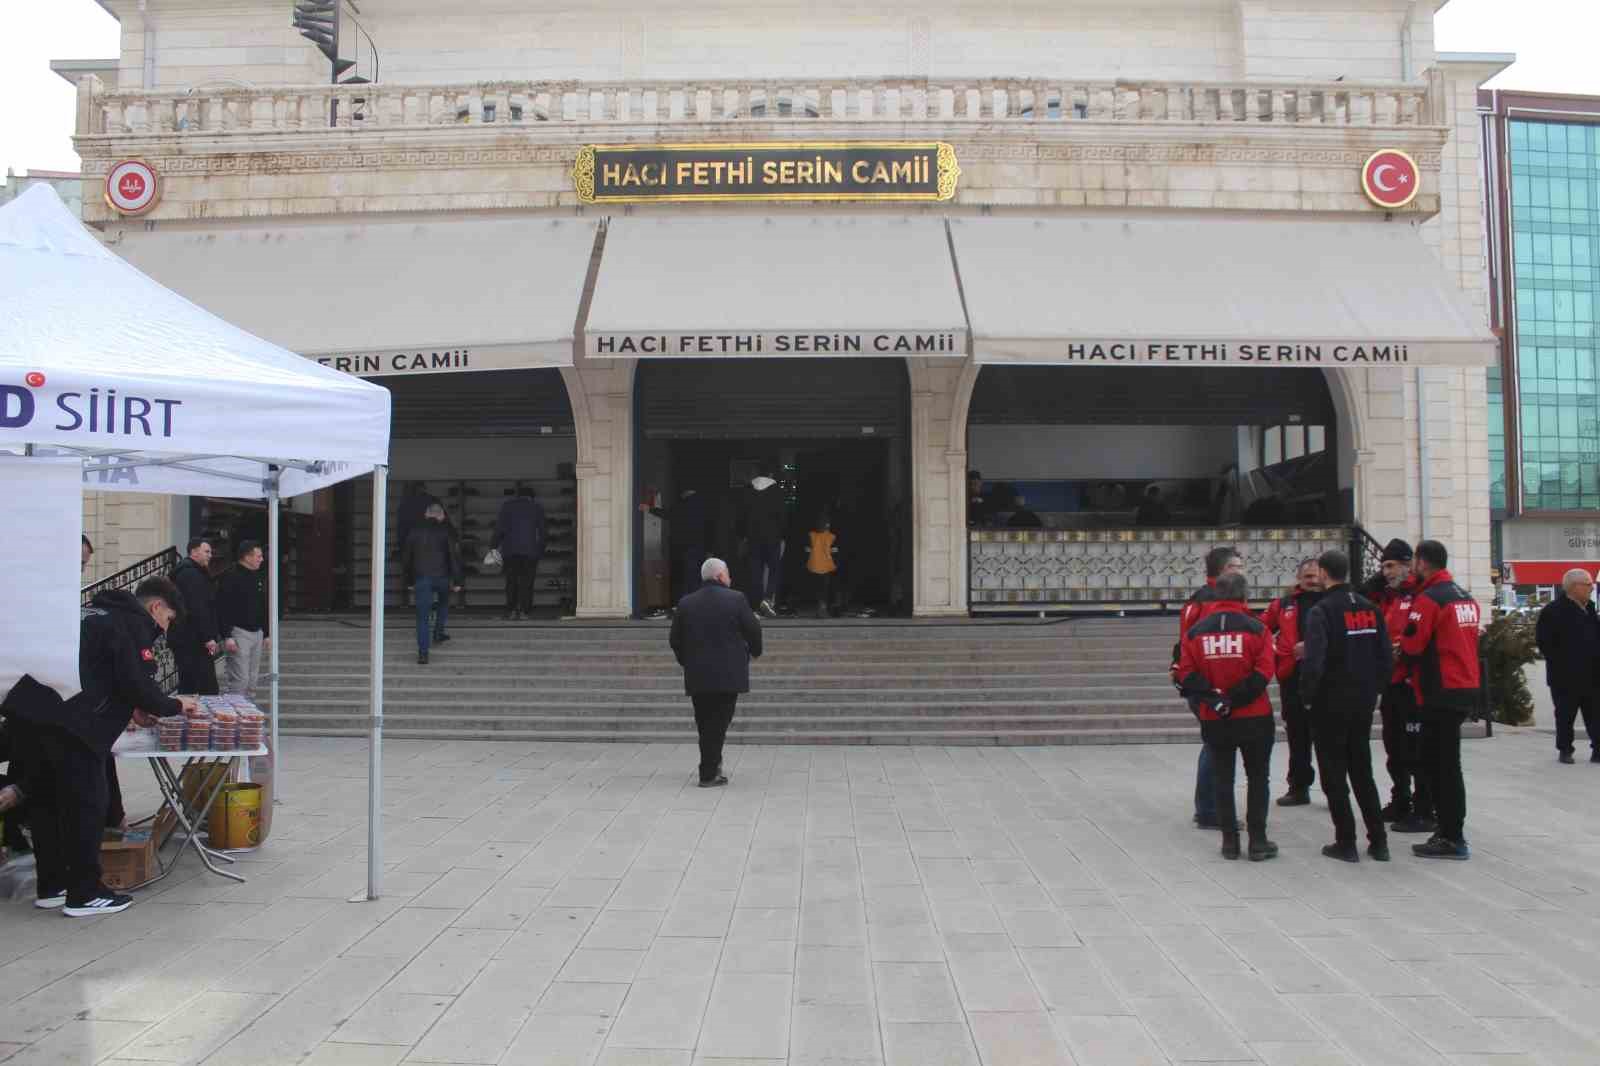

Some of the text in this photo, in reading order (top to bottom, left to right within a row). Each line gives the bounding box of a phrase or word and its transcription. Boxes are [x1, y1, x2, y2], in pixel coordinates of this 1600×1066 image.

[602, 162, 667, 187] HACI
[597, 335, 667, 353] HACI
[1067, 343, 1136, 361] HACI
